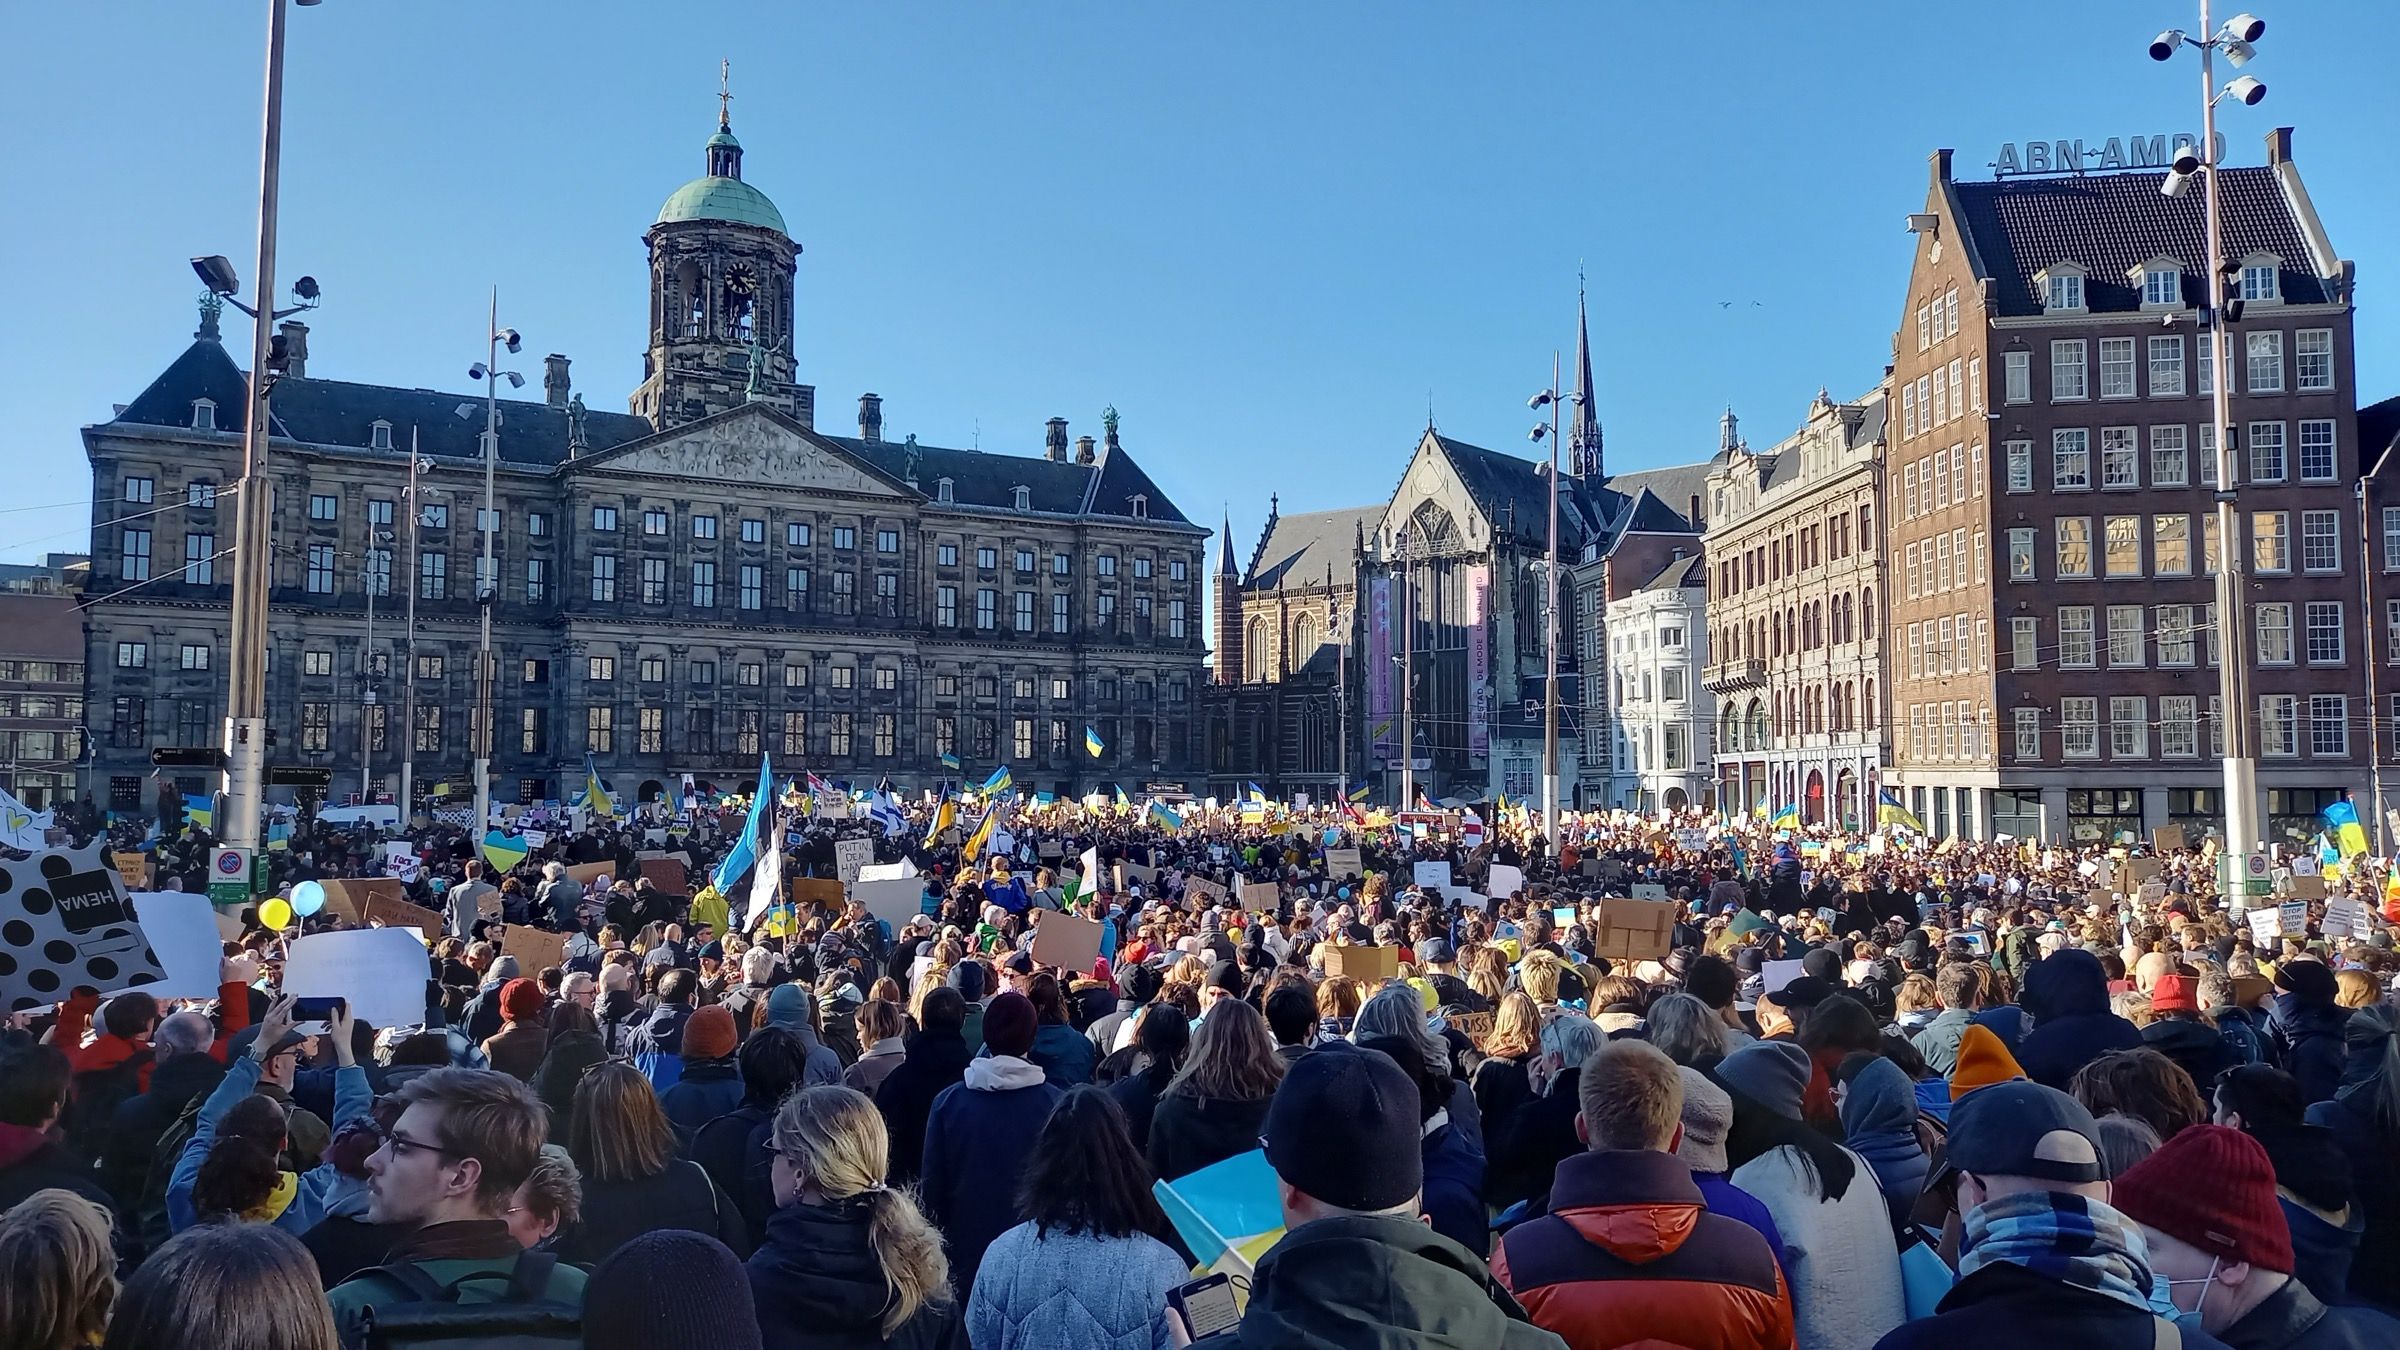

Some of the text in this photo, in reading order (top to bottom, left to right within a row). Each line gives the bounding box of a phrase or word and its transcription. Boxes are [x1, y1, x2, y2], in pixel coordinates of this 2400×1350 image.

[1995, 139, 2083, 176] ABN
[1476, 638, 1484, 667] MODE
[1476, 669, 1484, 681] DE
[1476, 687, 1484, 712] STAD
[845, 852, 864, 862] DEN
[58, 888, 115, 912] HEMA
[2281, 913, 2304, 921] PUTIN!
[2283, 920, 2302, 928] STOP
